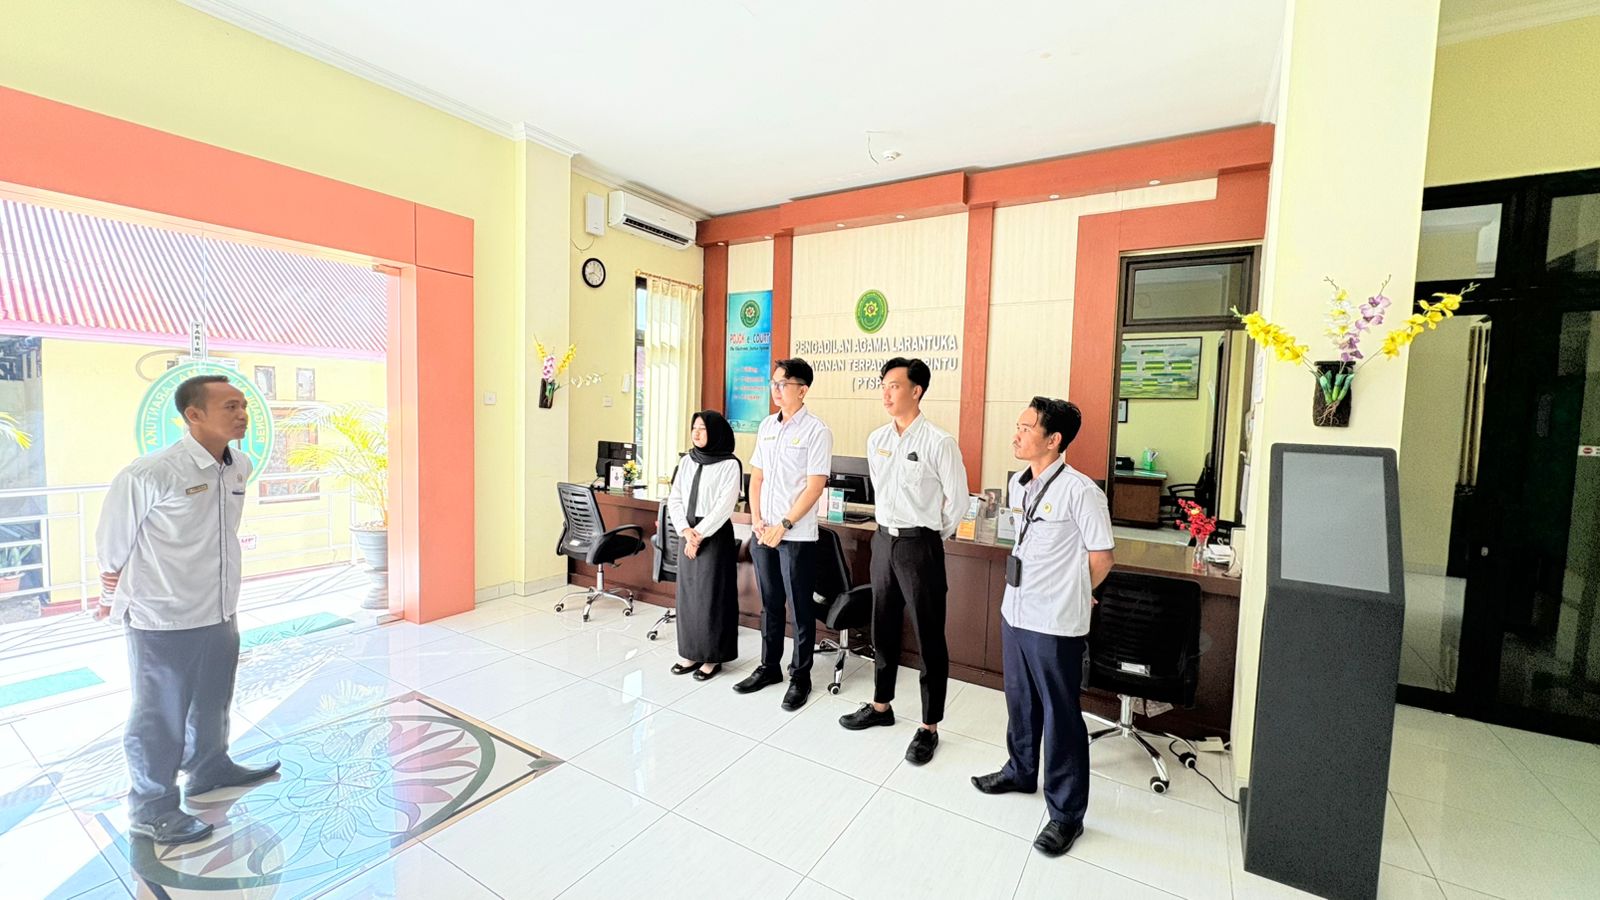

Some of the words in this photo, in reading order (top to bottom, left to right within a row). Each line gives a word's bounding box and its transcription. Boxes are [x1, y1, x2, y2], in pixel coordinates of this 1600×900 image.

[753, 332, 770, 344] COURT
[795, 339, 853, 355] PENGADILAN
[854, 337, 891, 353] AGAMA
[892, 335, 958, 352] LARANTUKA
[811, 359, 846, 371] AYANAN
[848, 359, 889, 371] TERPAD
